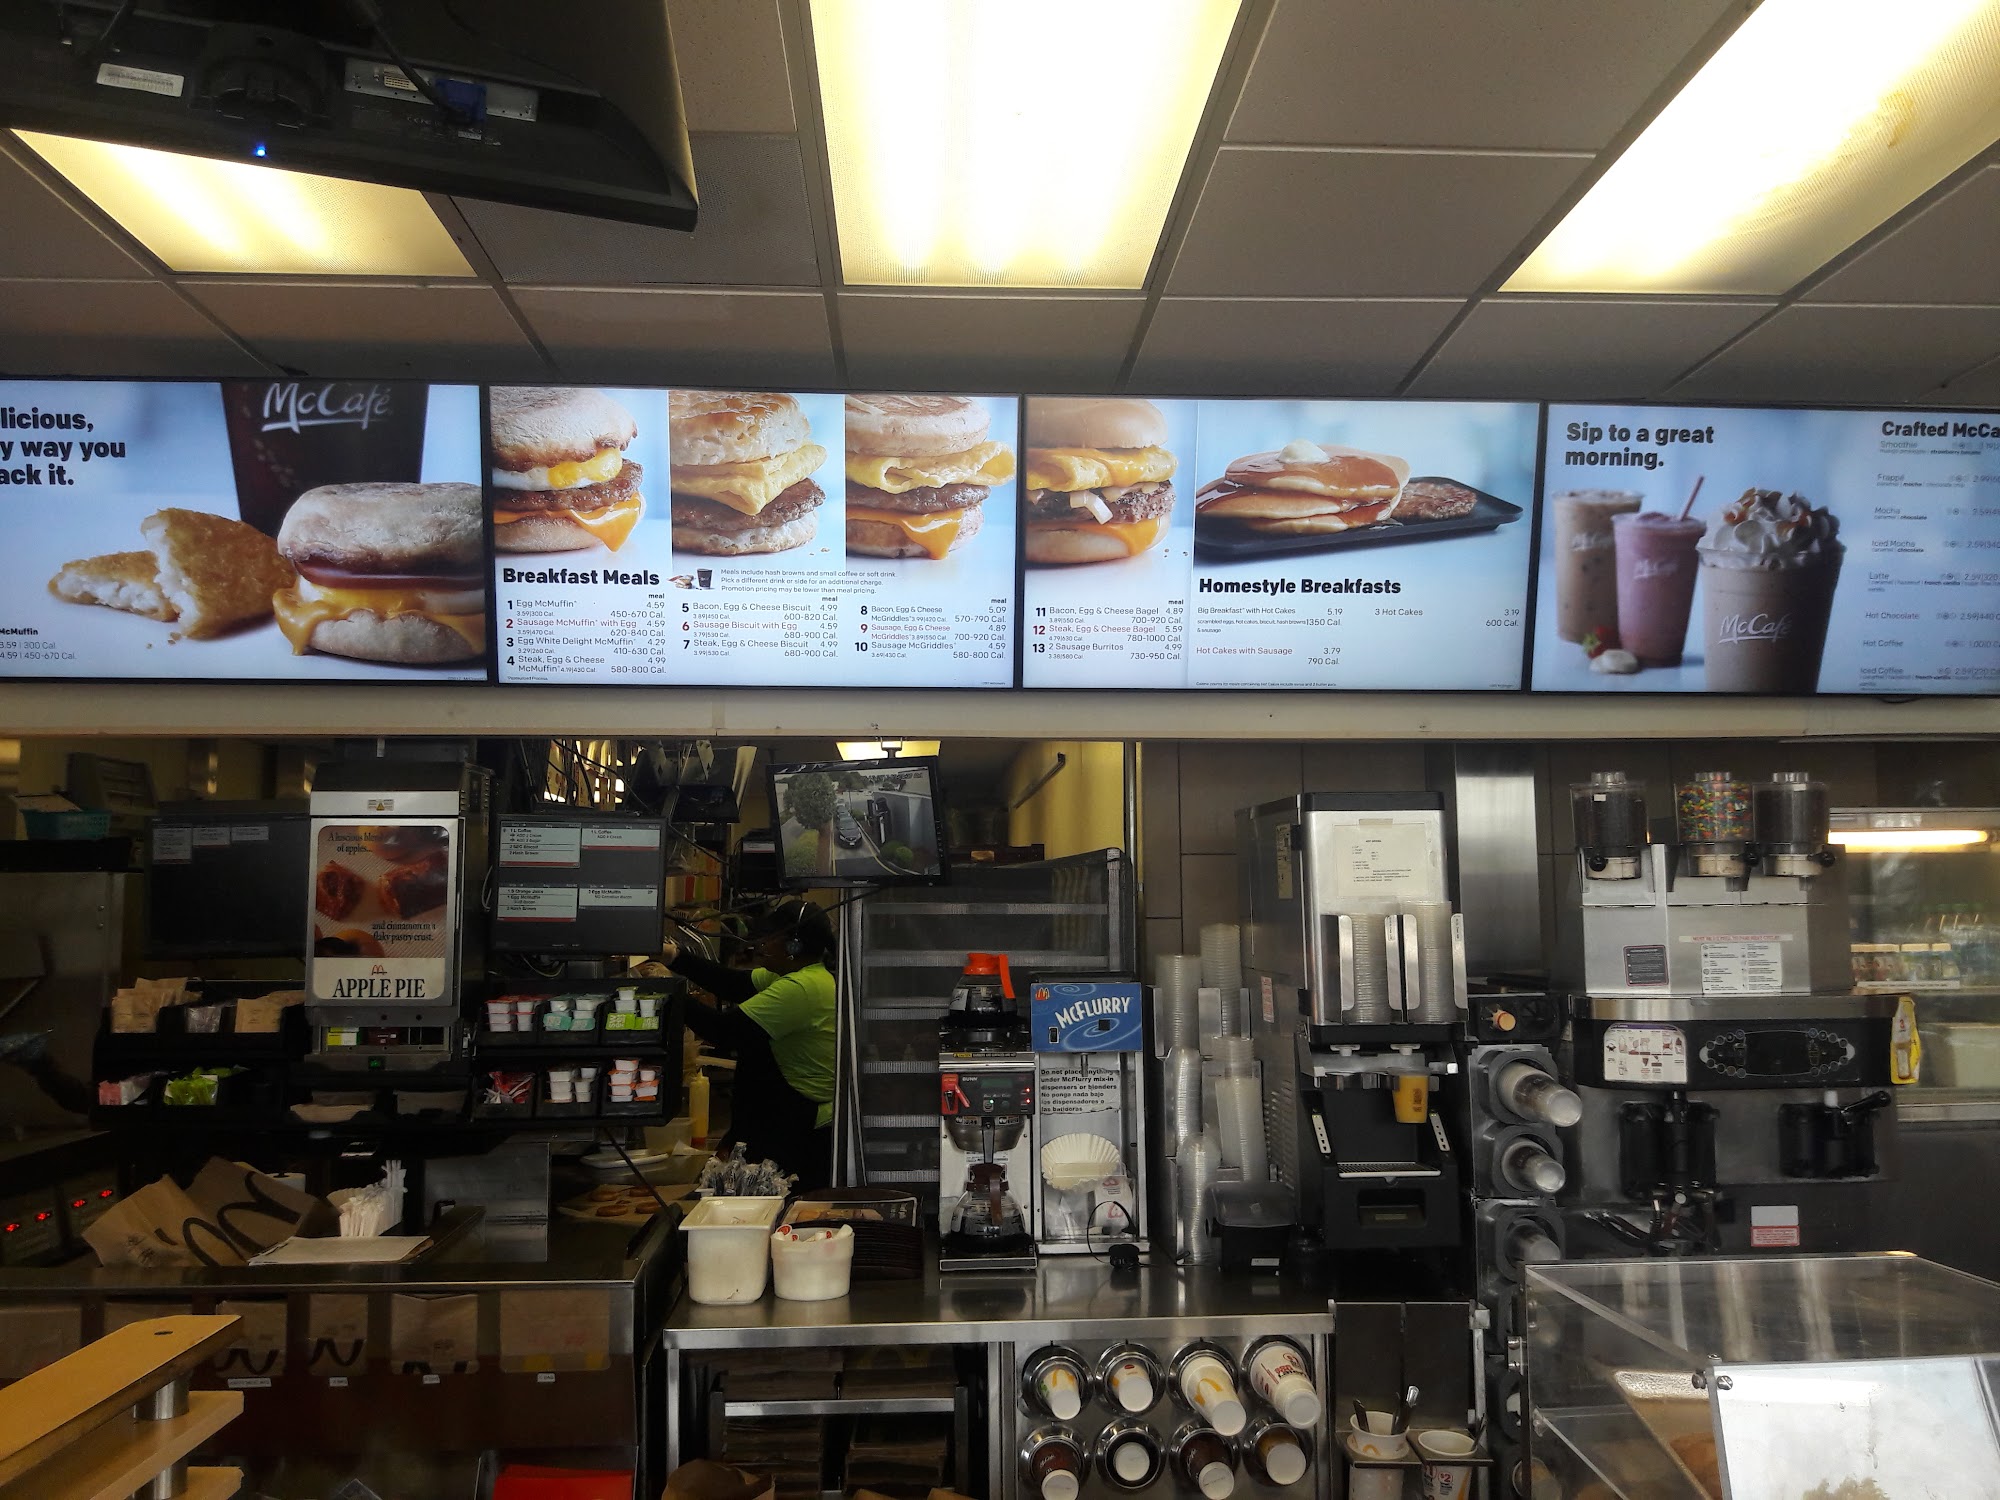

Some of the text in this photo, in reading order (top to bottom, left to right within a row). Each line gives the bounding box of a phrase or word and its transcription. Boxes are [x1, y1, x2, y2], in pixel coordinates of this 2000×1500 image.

[261, 383, 392, 434] McCafé
[1881, 420, 1949, 437] Crafted
[1566, 422, 1714, 446] Sip to a great
[21, 441, 73, 461] way
[79, 441, 126, 462] you
[1565, 447, 1664, 470] morning.
[48, 463, 74, 485] it.
[503, 568, 660, 585] Breakfast Meals
[1199, 578, 1402, 596] Homestyle Breakfasts
[507, 600, 513, 610] 1
[682, 603, 689, 613] 5
[723, 603, 740, 611] Egg
[1036, 608, 1046, 617] 11
[1049, 607, 1077, 615] Bacon,
[1079, 607, 1094, 615] Egg
[1197, 607, 1209, 615] Big
[1327, 608, 1343, 616] 5.19
[1374, 608, 1380, 616] 3
[1382, 608, 1396, 616] Hot
[506, 619, 514, 629] 2
[517, 619, 554, 627] Sausage
[620, 620, 637, 628] Egg
[682, 621, 690, 631] 6
[693, 621, 730, 629] Sausage
[732, 621, 760, 629] Biscuit
[1486, 619, 1502, 627] 600
[1033, 625, 1046, 635] 12
[1076, 625, 1091, 633] Egg
[506, 638, 514, 647] 3
[517, 637, 534, 645] Egg
[562, 638, 592, 646] Delight
[683, 640, 690, 649] 7
[722, 640, 738, 648] Egg
[855, 642, 868, 652] 10
[871, 642, 907, 650] Sausage
[1032, 644, 1045, 653] 13
[1056, 643, 1090, 651] Sausage
[1258, 647, 1293, 655] Sausage
[506, 656, 515, 665] 4
[546, 656, 563, 664] Egg
[574, 656, 605, 664] Cheese
[333, 978, 426, 998] APPLE PIE
